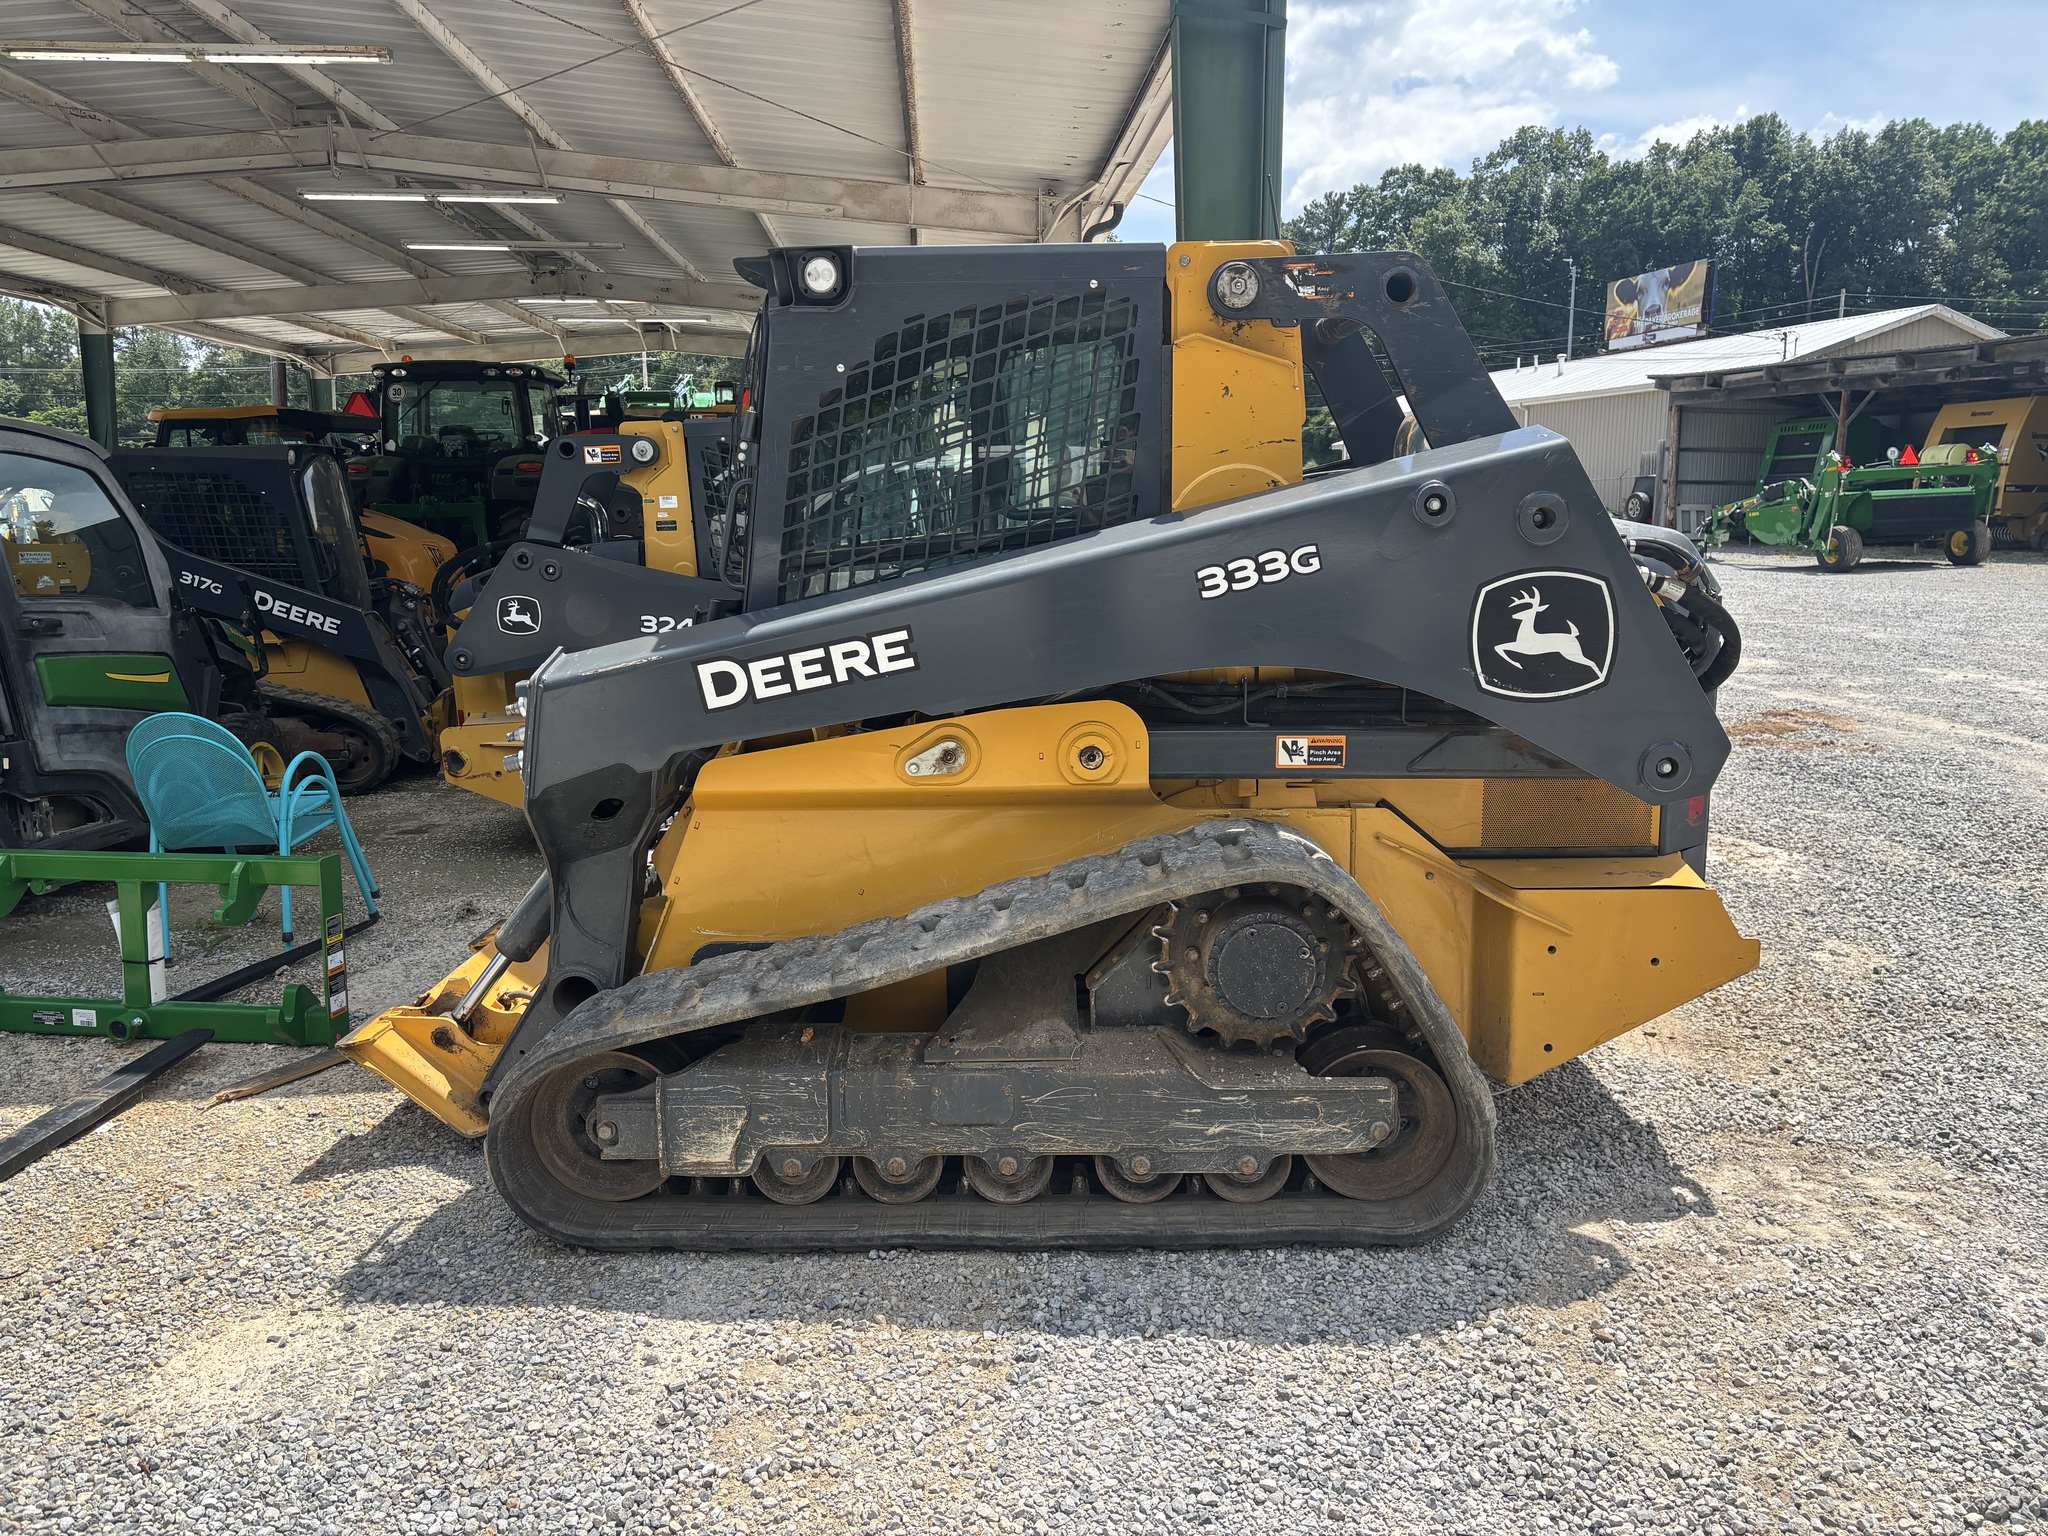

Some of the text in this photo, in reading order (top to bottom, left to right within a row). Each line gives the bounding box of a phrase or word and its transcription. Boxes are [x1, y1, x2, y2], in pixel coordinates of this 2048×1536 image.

[1633, 318, 1644, 328] THE
[1663, 307, 1700, 321] BROKERAGE
[392, 388, 402, 396] 30
[179, 571, 223, 595] 317G
[1200, 545, 1320, 598] 333G
[254, 590, 342, 635] DEERE
[697, 630, 915, 710] DEERE
